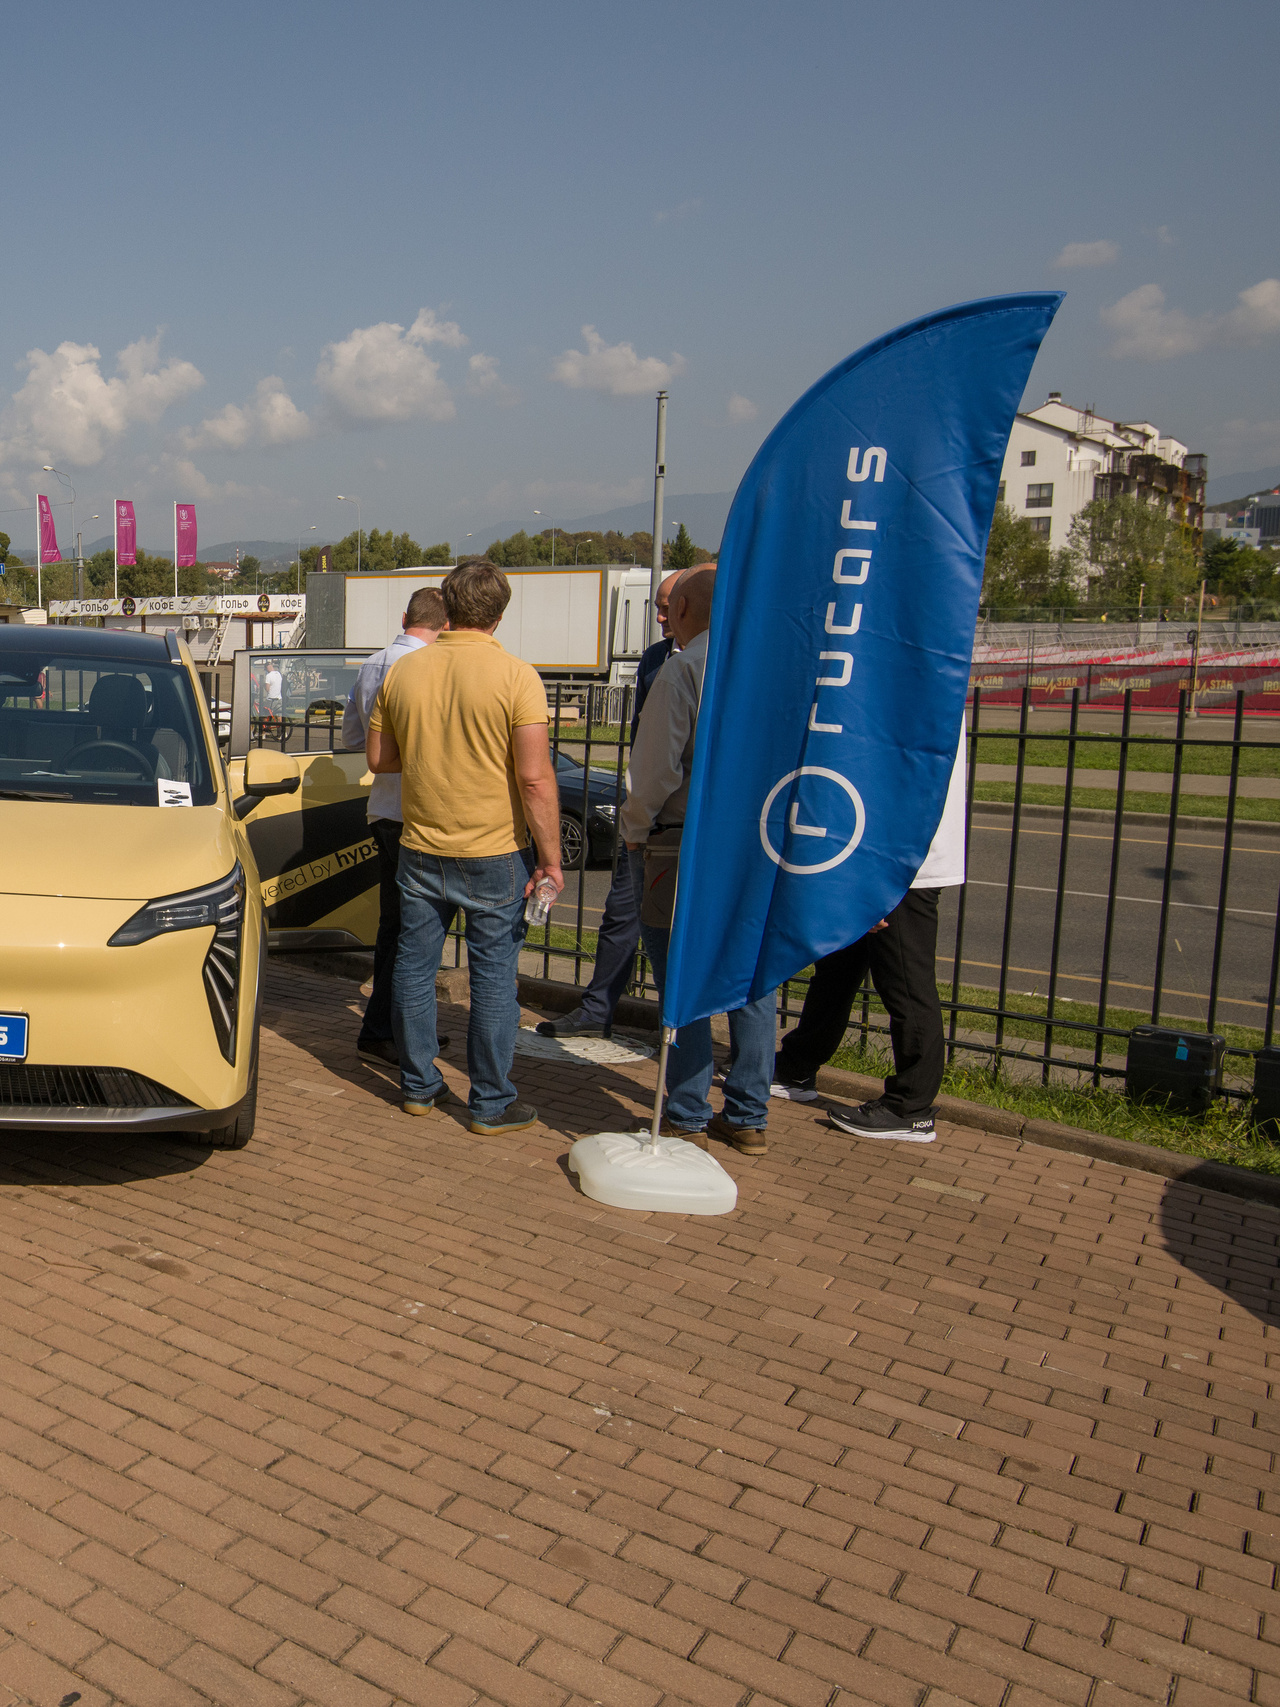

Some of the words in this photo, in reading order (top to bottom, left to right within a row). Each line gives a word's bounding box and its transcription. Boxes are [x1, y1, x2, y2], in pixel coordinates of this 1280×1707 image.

[807, 446, 888, 734] rucars
[81, 602, 109, 612] ГОЛЬФ
[149, 601, 174, 610] КОФЕ
[221, 599, 249, 609] ГОЛЬФ
[281, 599, 302, 608] КОФЕ
[983, 675, 1004, 686] STAR
[1028, 676, 1048, 686] IRON
[1056, 677, 1078, 687] STAR
[1129, 678, 1151, 689] STAR
[1209, 679, 1233, 690] STAR
[308, 860, 331, 879] by
[912, 1119, 934, 1129] HOKA
